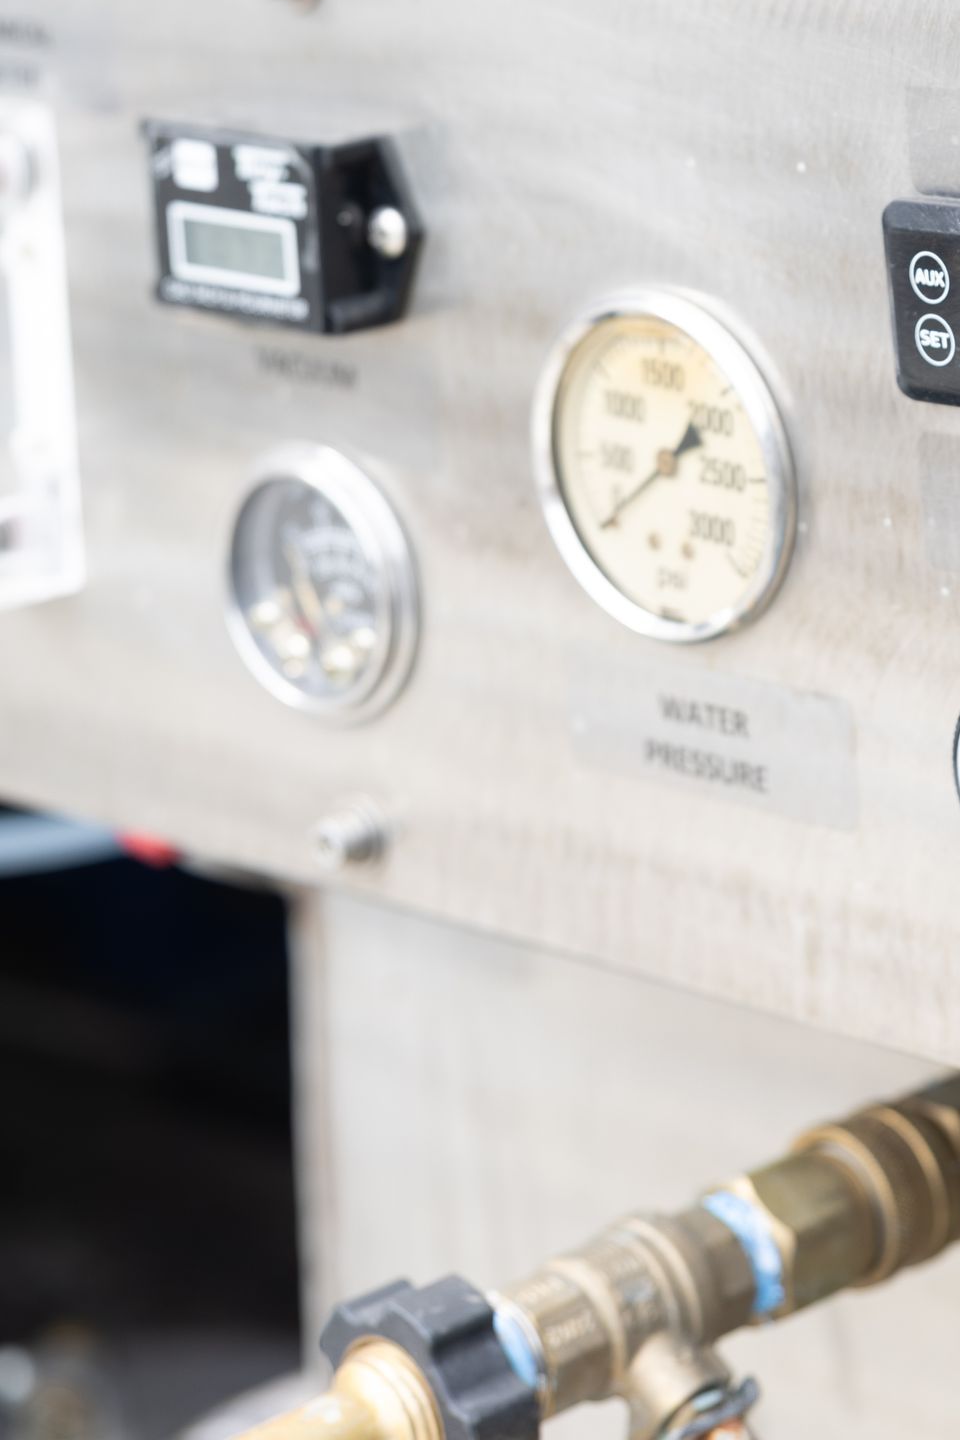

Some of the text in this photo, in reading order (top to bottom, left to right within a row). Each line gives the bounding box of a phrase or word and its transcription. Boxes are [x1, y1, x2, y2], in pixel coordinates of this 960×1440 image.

[914, 267, 946, 289] AUX
[919, 330, 949, 350] SET
[640, 357, 686, 393] 1500
[699, 456, 747, 493] 2500
[657, 693, 751, 738] WATER
[642, 737, 770, 794] PRESSURE
